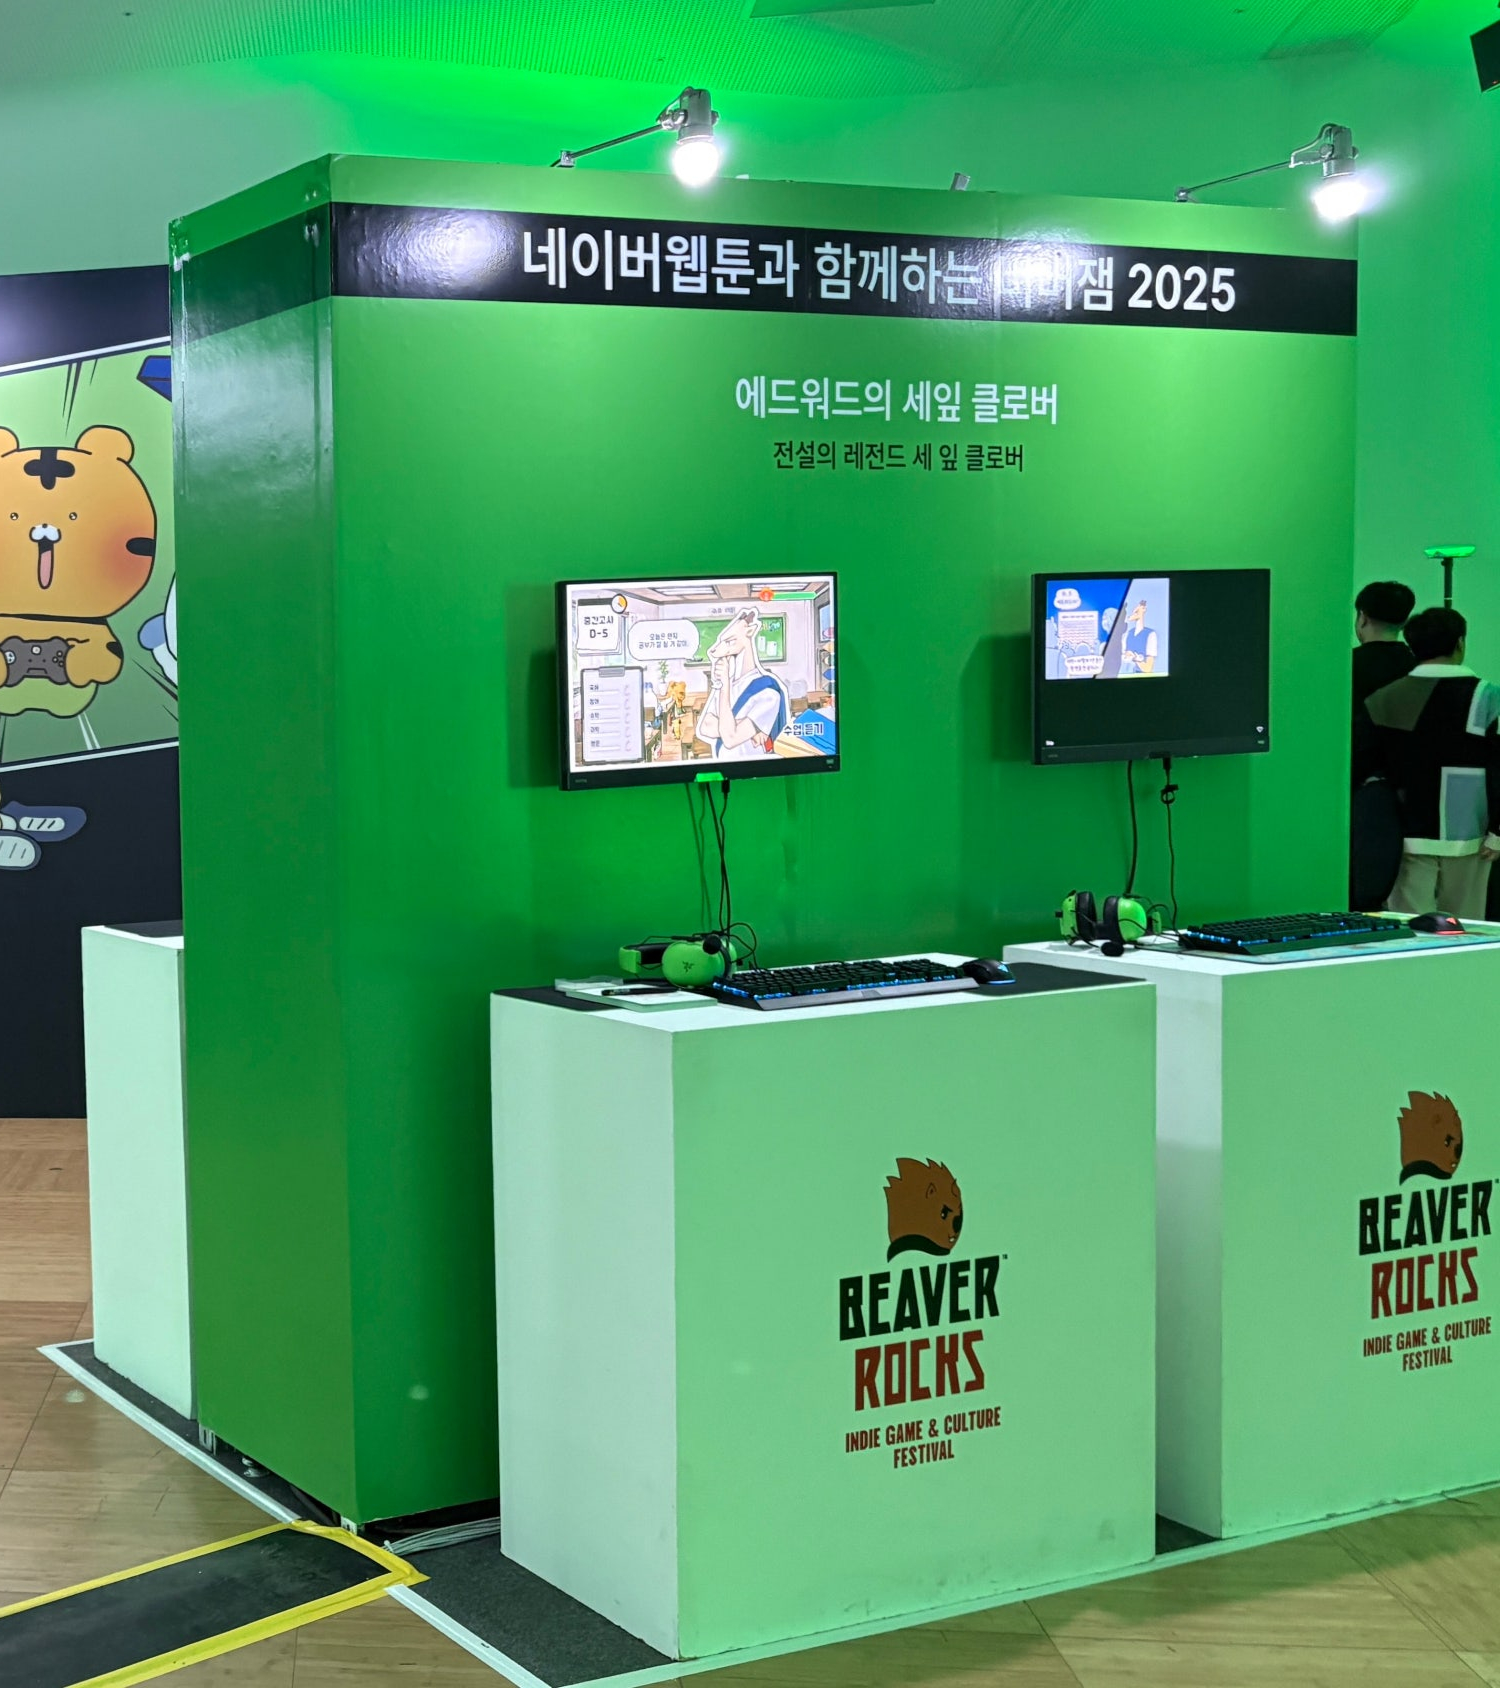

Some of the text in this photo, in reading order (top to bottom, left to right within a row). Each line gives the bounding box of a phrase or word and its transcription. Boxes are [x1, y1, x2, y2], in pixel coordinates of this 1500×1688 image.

[522, 227, 800, 298] 네이버웹툰과
[814, 241, 982, 307] 함께하는
[1128, 262, 1236, 312] 2025
[735, 375, 1058, 425] 에드워드의 세잎 클로버
[773, 440, 1024, 473] 전설의 레전드 세 잎 클로버
[589, 629, 609, 639] D-5
[783, 724, 802, 736] 수업
[1359, 1179, 1493, 1256] BEAVER
[840, 1255, 1000, 1341] BEAVER
[1371, 1246, 1479, 1320] ROCKS
[1363, 1316, 1492, 1357] INDIE GAME & CULTURE
[1402, 1345, 1453, 1372] FESTIVAL
[855, 1329, 985, 1412] ROCKS
[845, 1406, 1002, 1453] INDIE GAME & CULTURE
[893, 1439, 955, 1469] FESTIVAL
